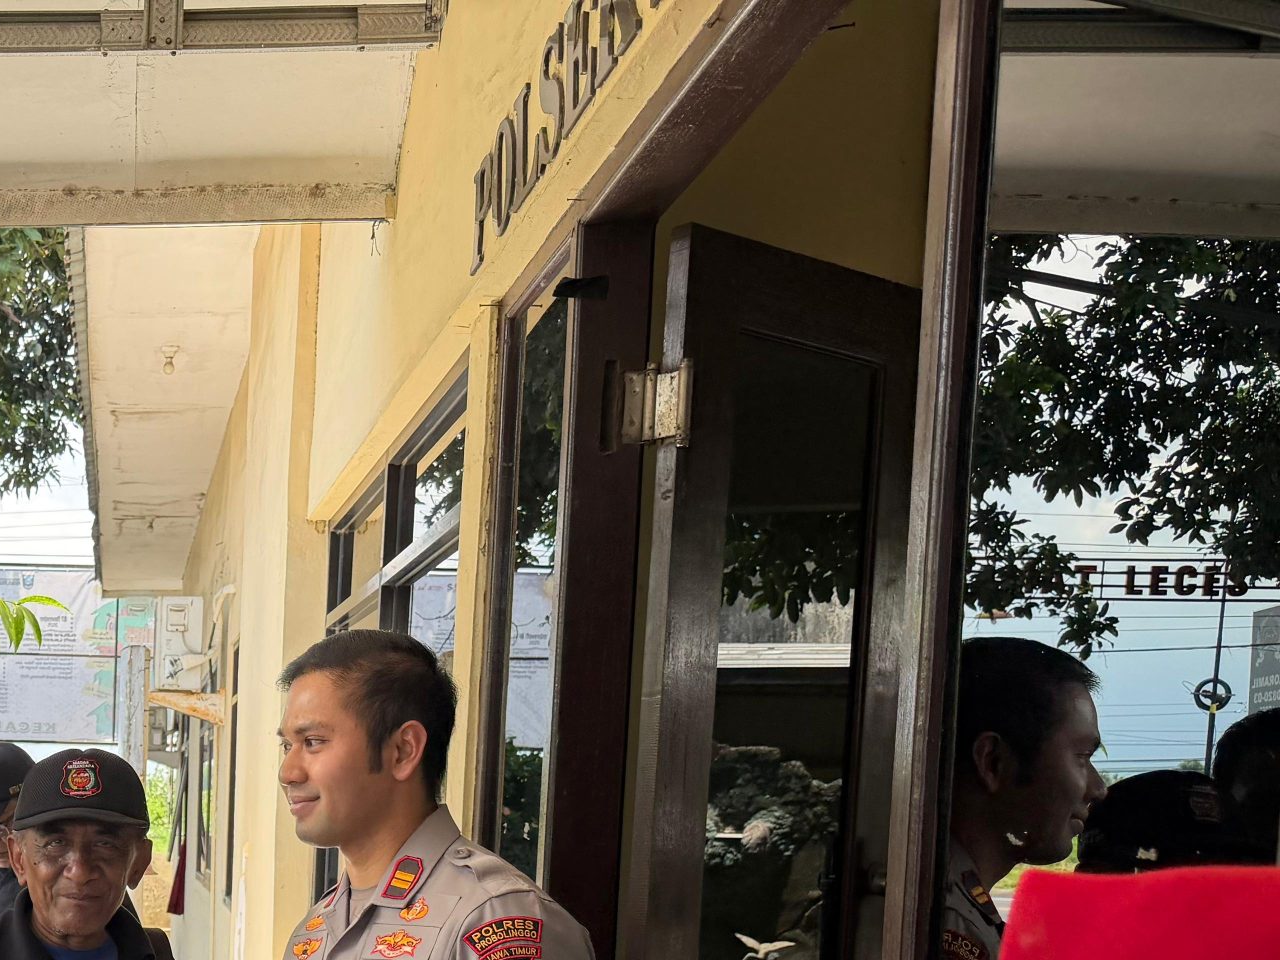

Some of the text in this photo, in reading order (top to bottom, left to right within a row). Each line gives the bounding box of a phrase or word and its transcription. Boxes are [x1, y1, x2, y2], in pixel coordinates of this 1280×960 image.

[471, 919, 534, 943] POLRES
[475, 928, 537, 952] PROBOLINGGO
[509, 947, 537, 956] TIMUR
